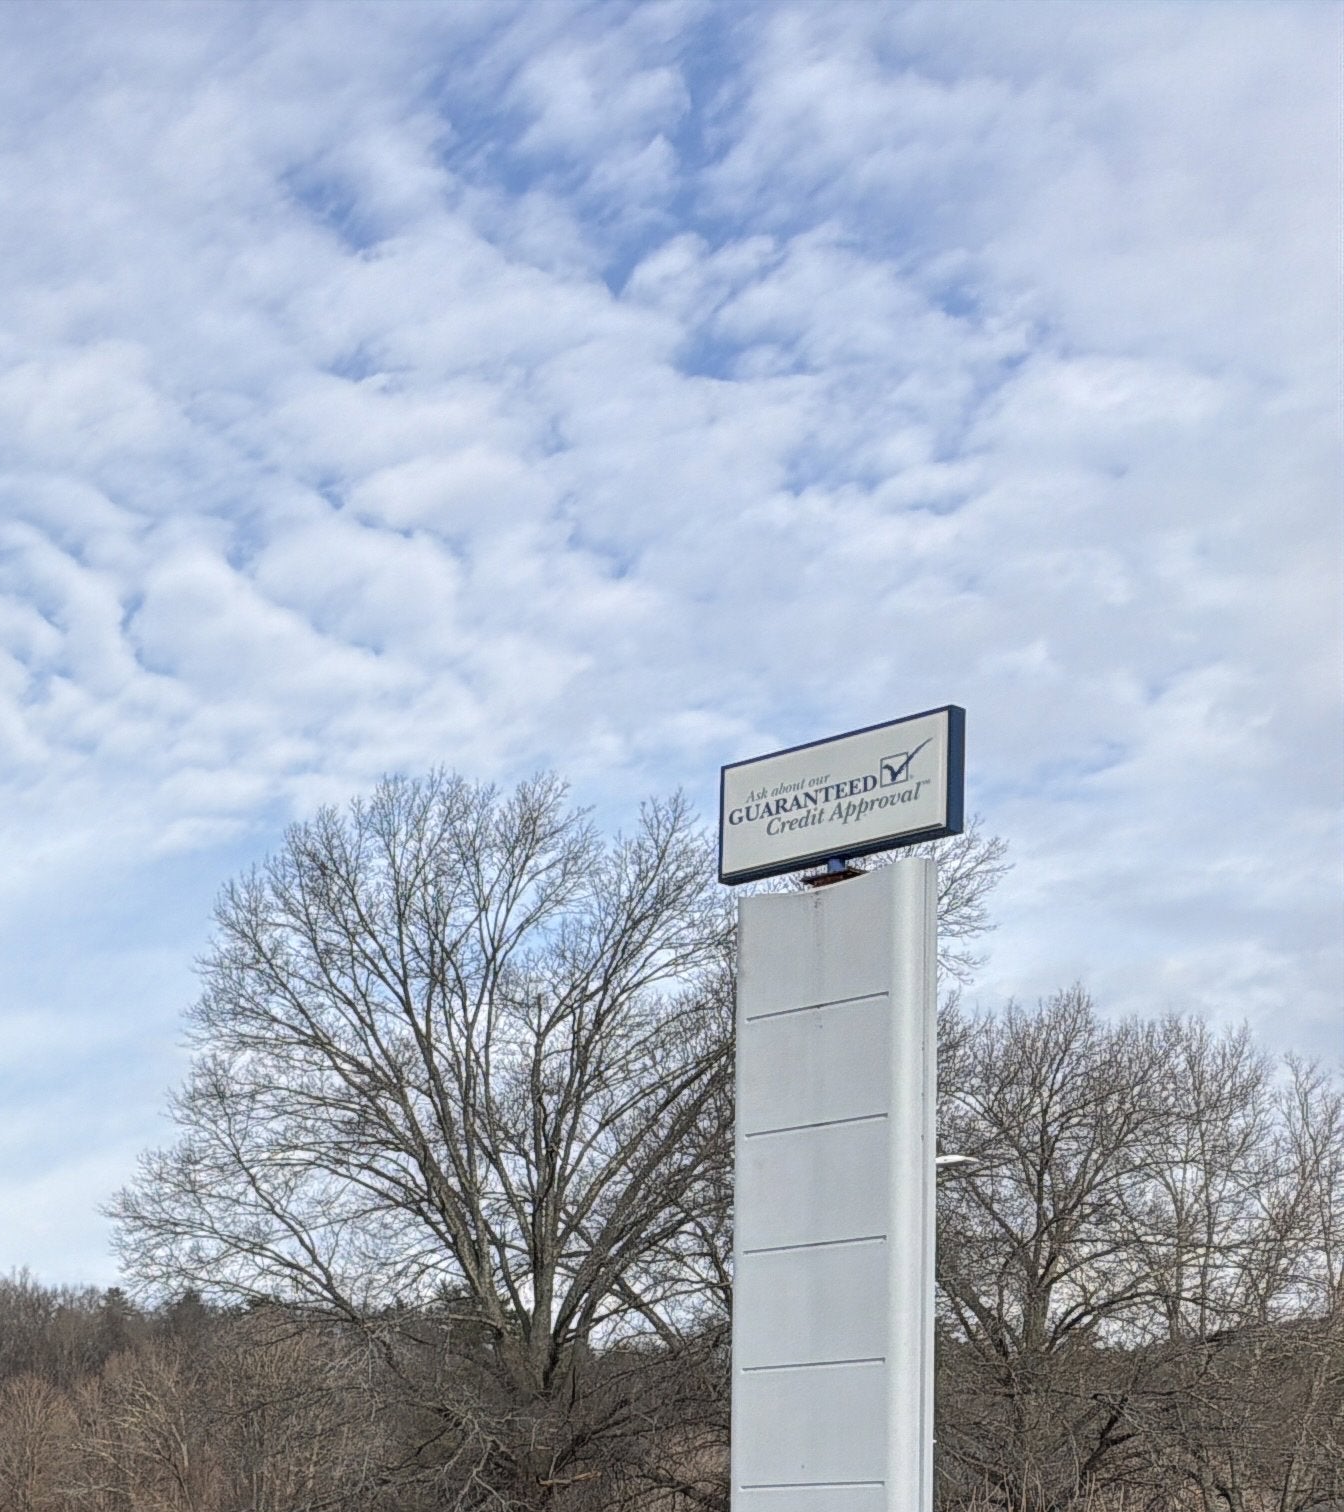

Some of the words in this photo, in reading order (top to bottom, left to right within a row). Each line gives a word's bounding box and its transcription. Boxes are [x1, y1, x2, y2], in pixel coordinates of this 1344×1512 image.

[728, 774, 877, 826] GUARANTEED
[744, 787, 768, 804] Ask
[770, 778, 805, 798] about
[807, 774, 831, 788] our
[766, 806, 825, 836] Credit
[828, 781, 921, 825] Approval
